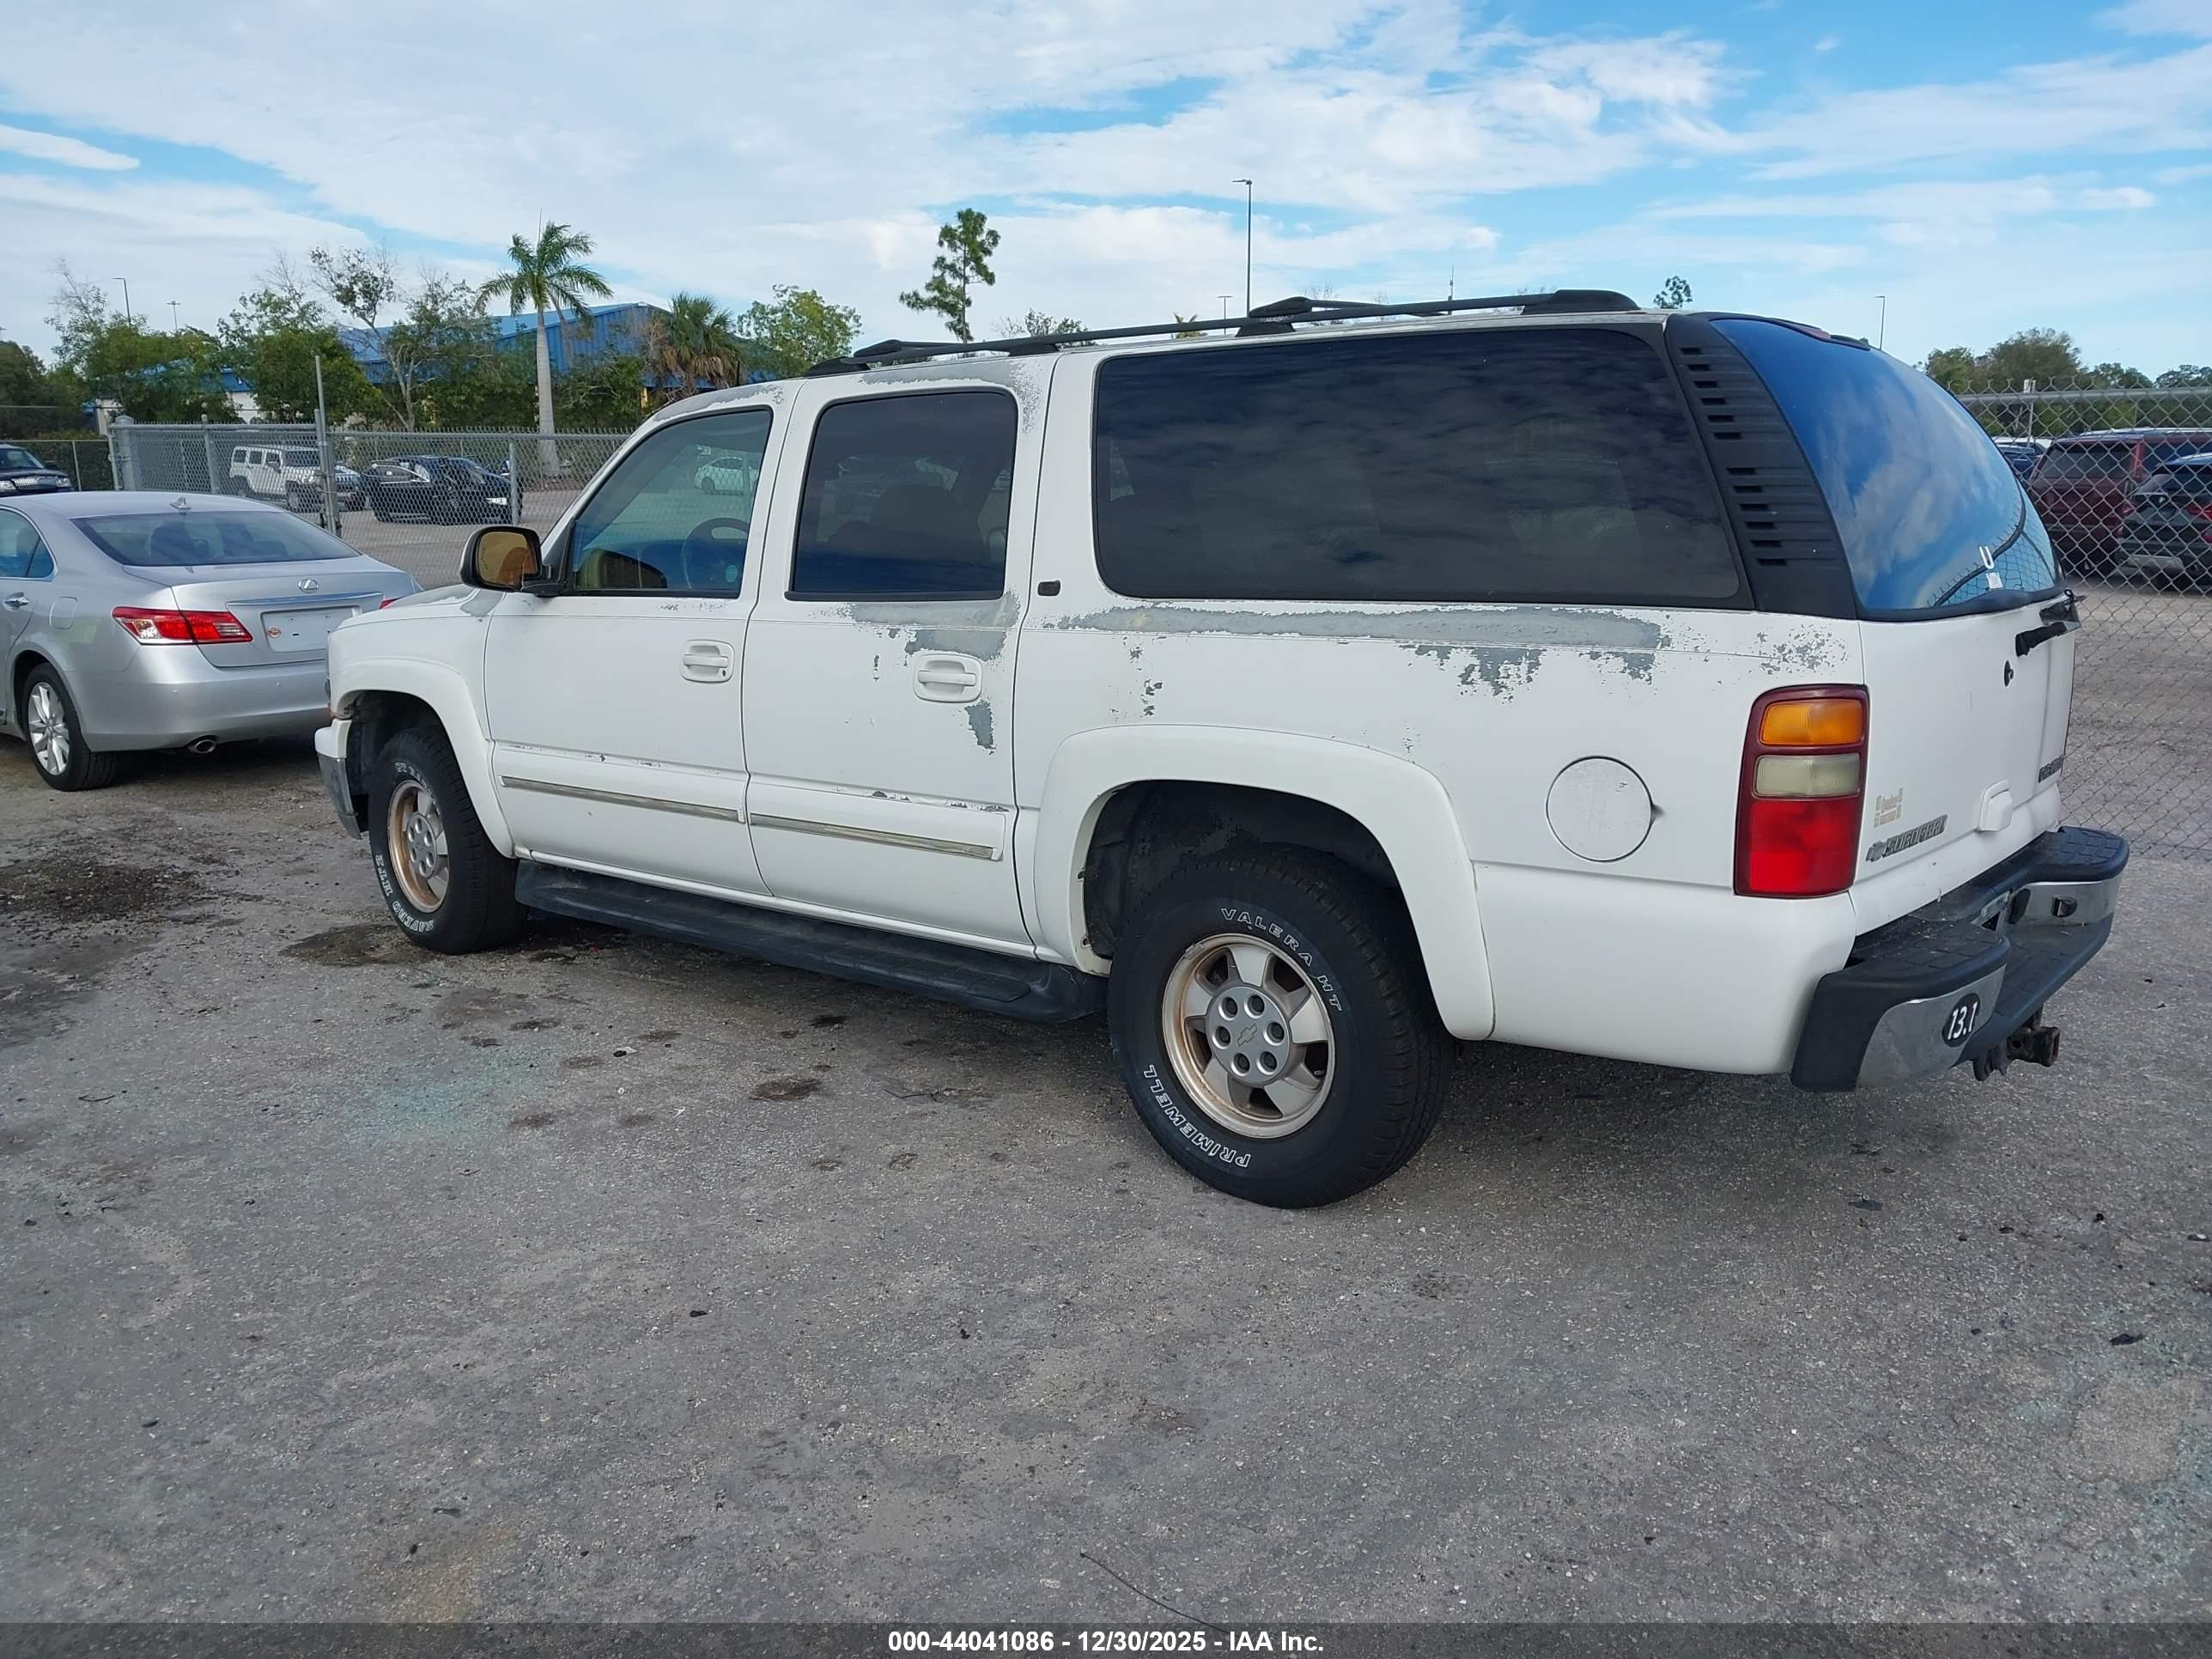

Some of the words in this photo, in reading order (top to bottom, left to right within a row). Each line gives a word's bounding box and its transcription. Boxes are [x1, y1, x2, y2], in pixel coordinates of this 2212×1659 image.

[1220, 908, 1313, 968] VALERA
[1316, 975, 1343, 1012] HT
[1948, 1000, 1978, 1040] 13.1
[1143, 1064, 1251, 1168] PRIMEWELL
